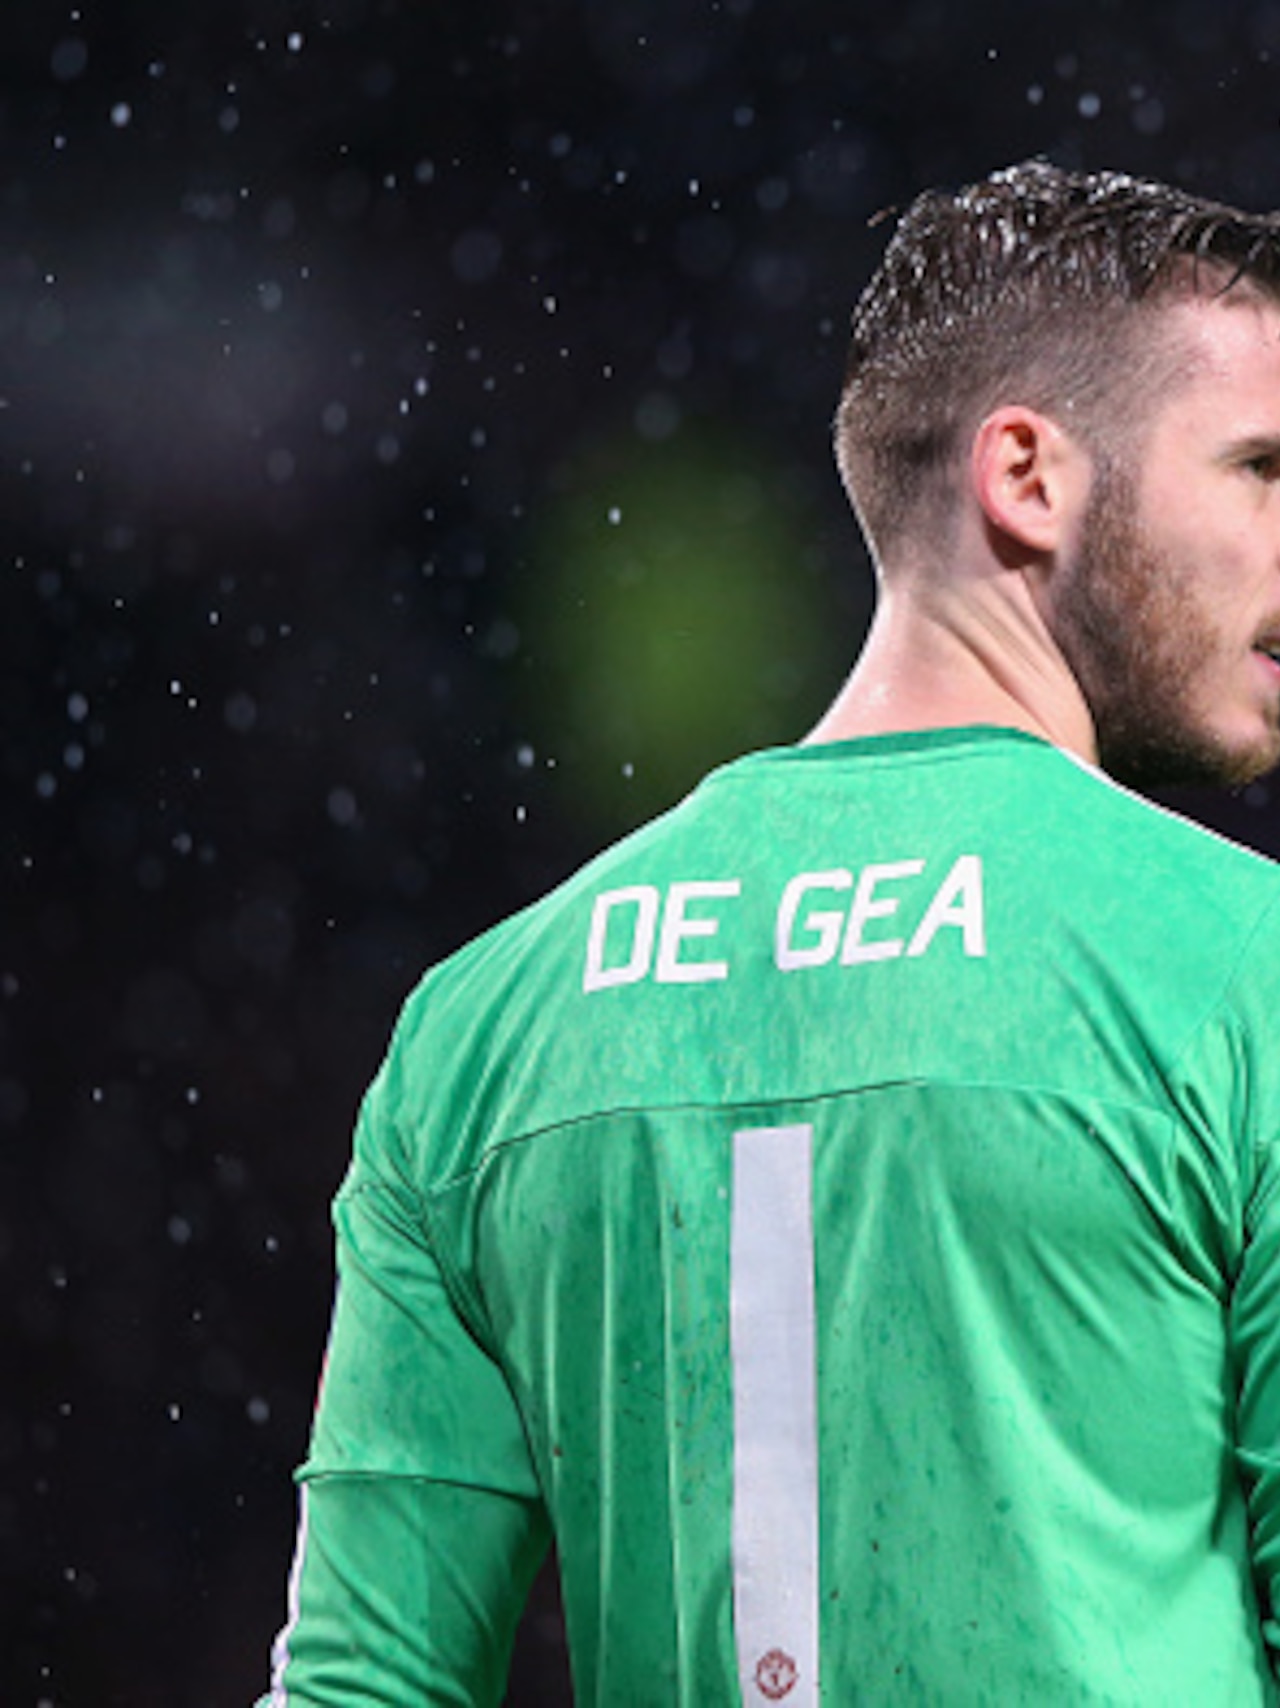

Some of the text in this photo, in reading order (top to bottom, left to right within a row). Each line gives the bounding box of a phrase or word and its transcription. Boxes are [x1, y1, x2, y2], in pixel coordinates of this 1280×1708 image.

[583, 855, 986, 992] DE GEA
[731, 1124, 819, 1708] 1
